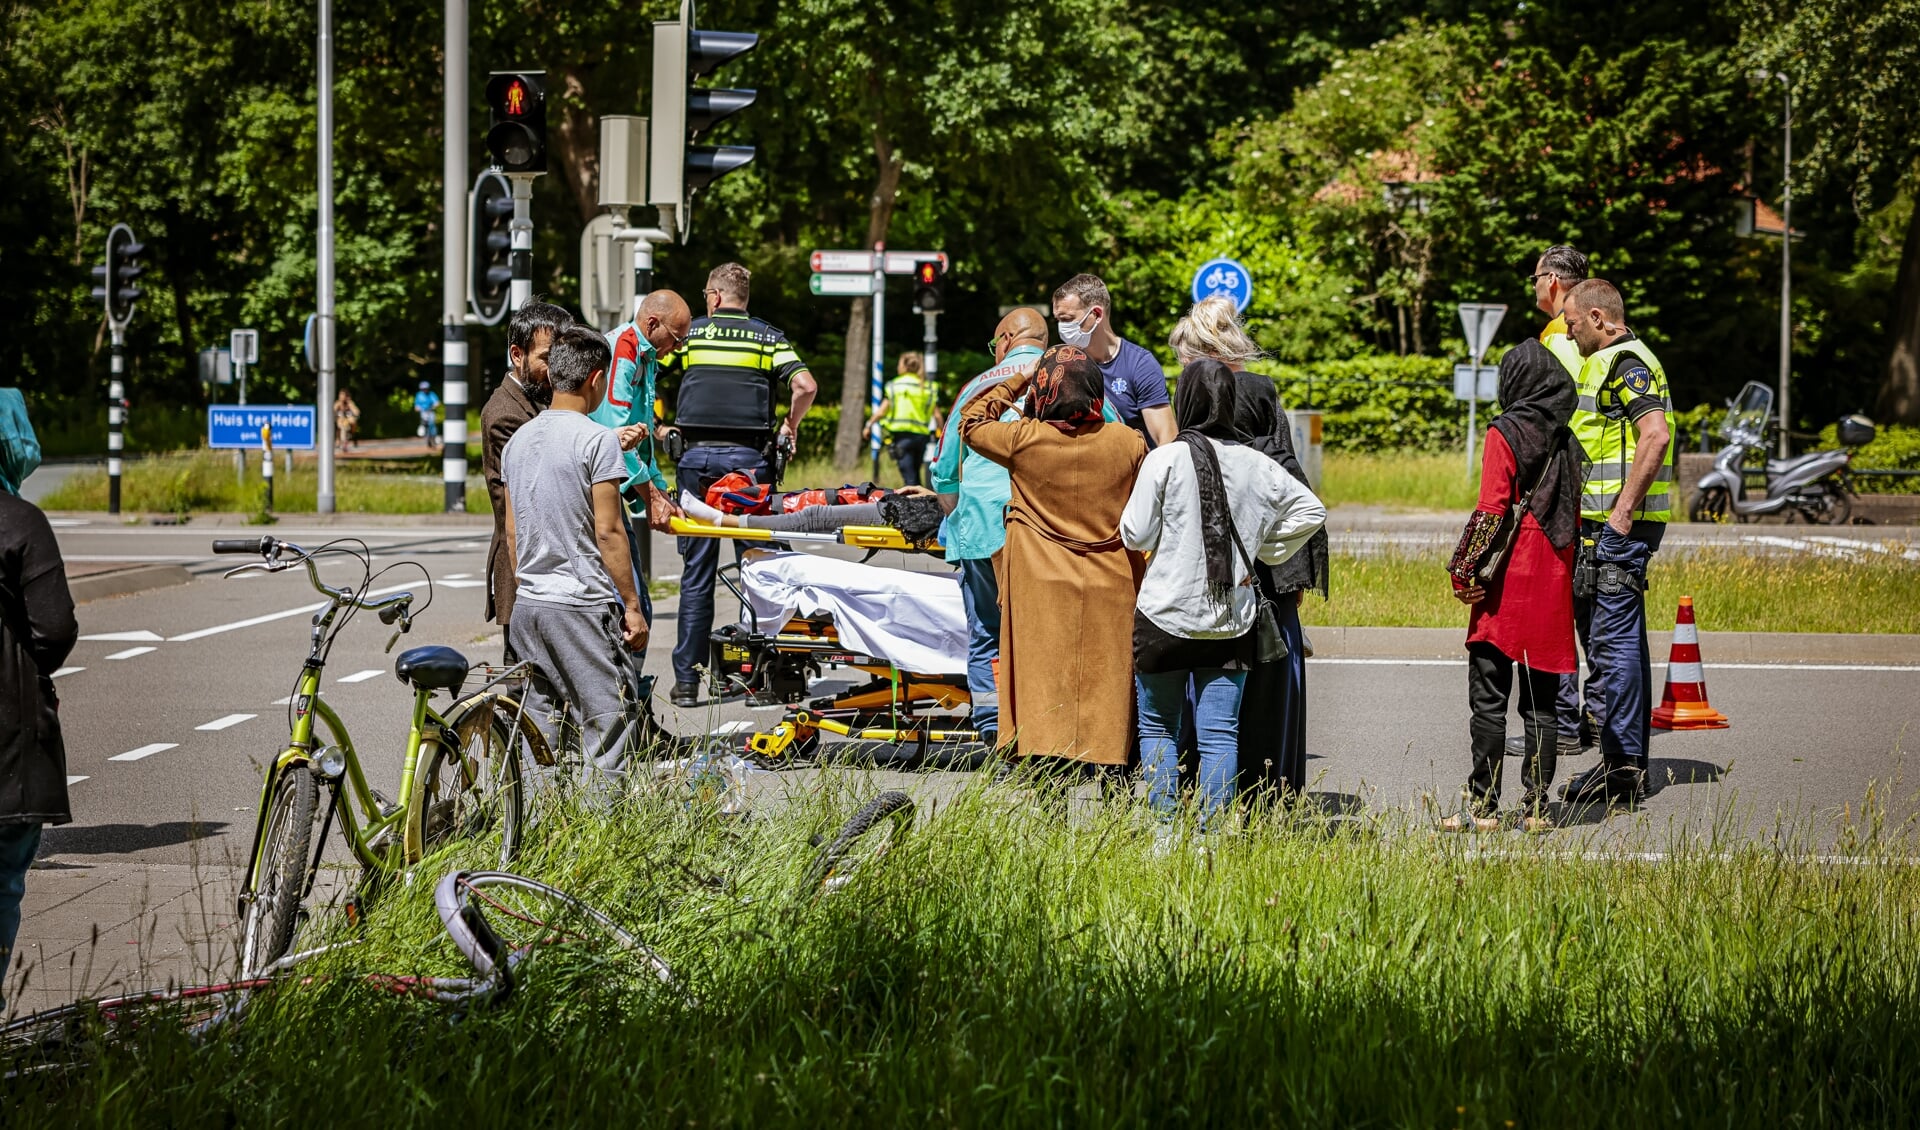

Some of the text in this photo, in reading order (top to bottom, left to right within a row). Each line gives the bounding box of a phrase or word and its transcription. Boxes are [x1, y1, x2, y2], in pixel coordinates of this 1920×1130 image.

[697, 322, 755, 340] POLITIE
[214, 412, 309, 428] Huis ter Heide
